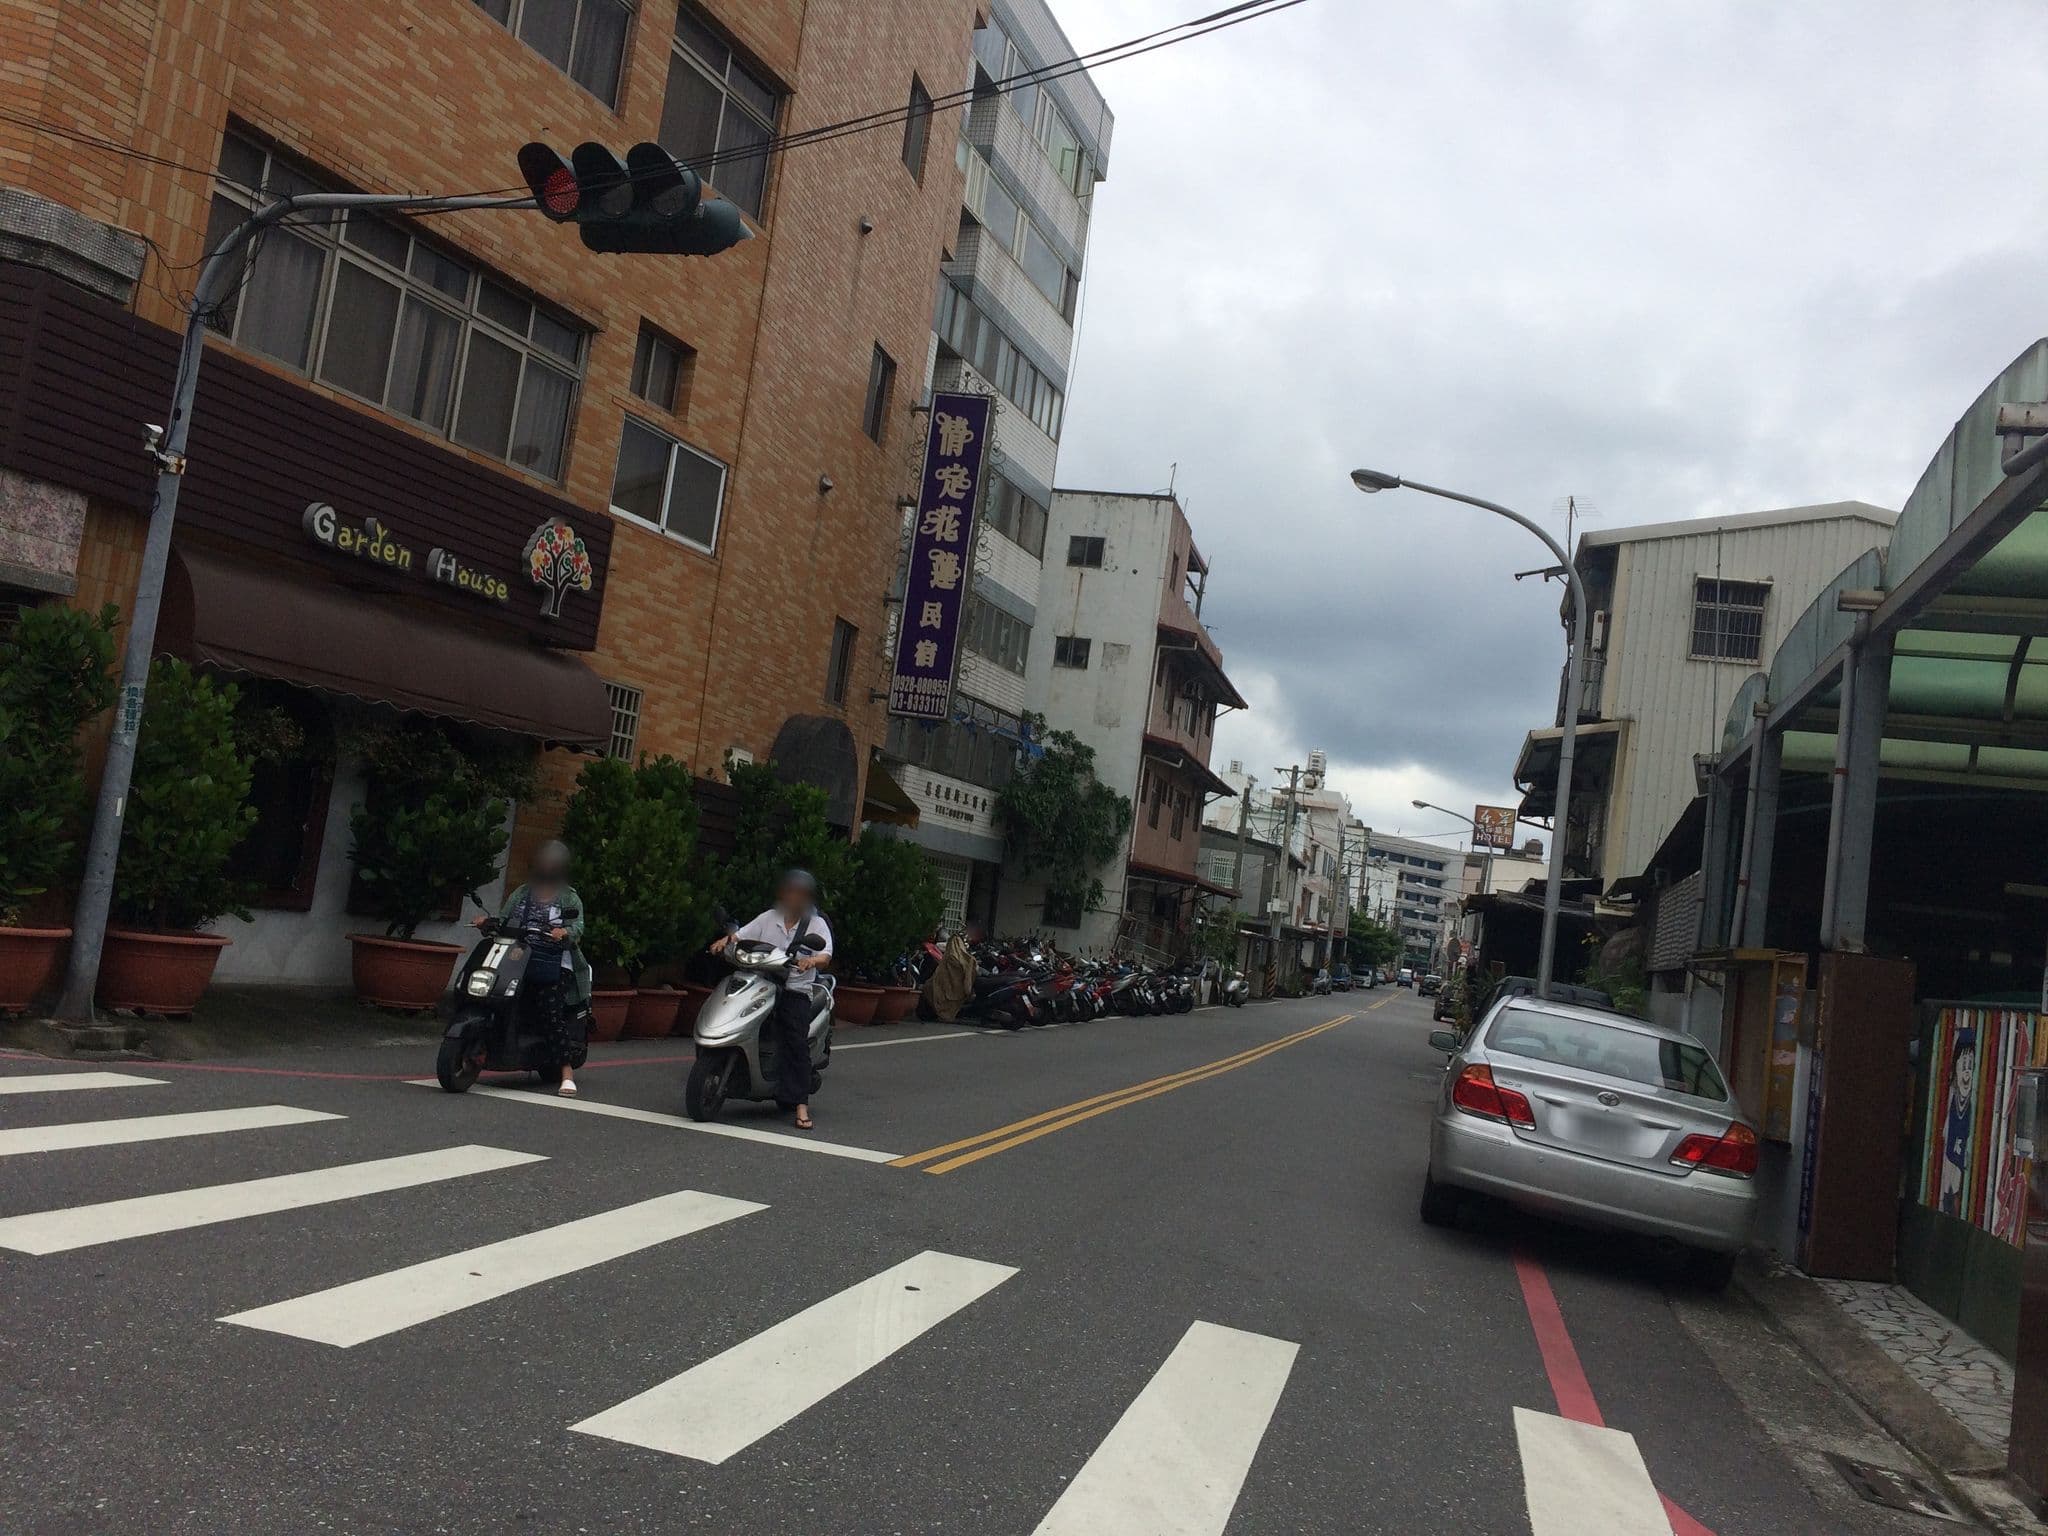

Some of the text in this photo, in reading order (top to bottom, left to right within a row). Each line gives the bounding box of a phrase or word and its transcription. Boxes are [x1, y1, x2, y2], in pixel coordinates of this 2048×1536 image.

[306, 503, 509, 600] Garden House
[892, 692, 946, 714] 03-8333119
[1476, 832, 1511, 844] HOTEL
